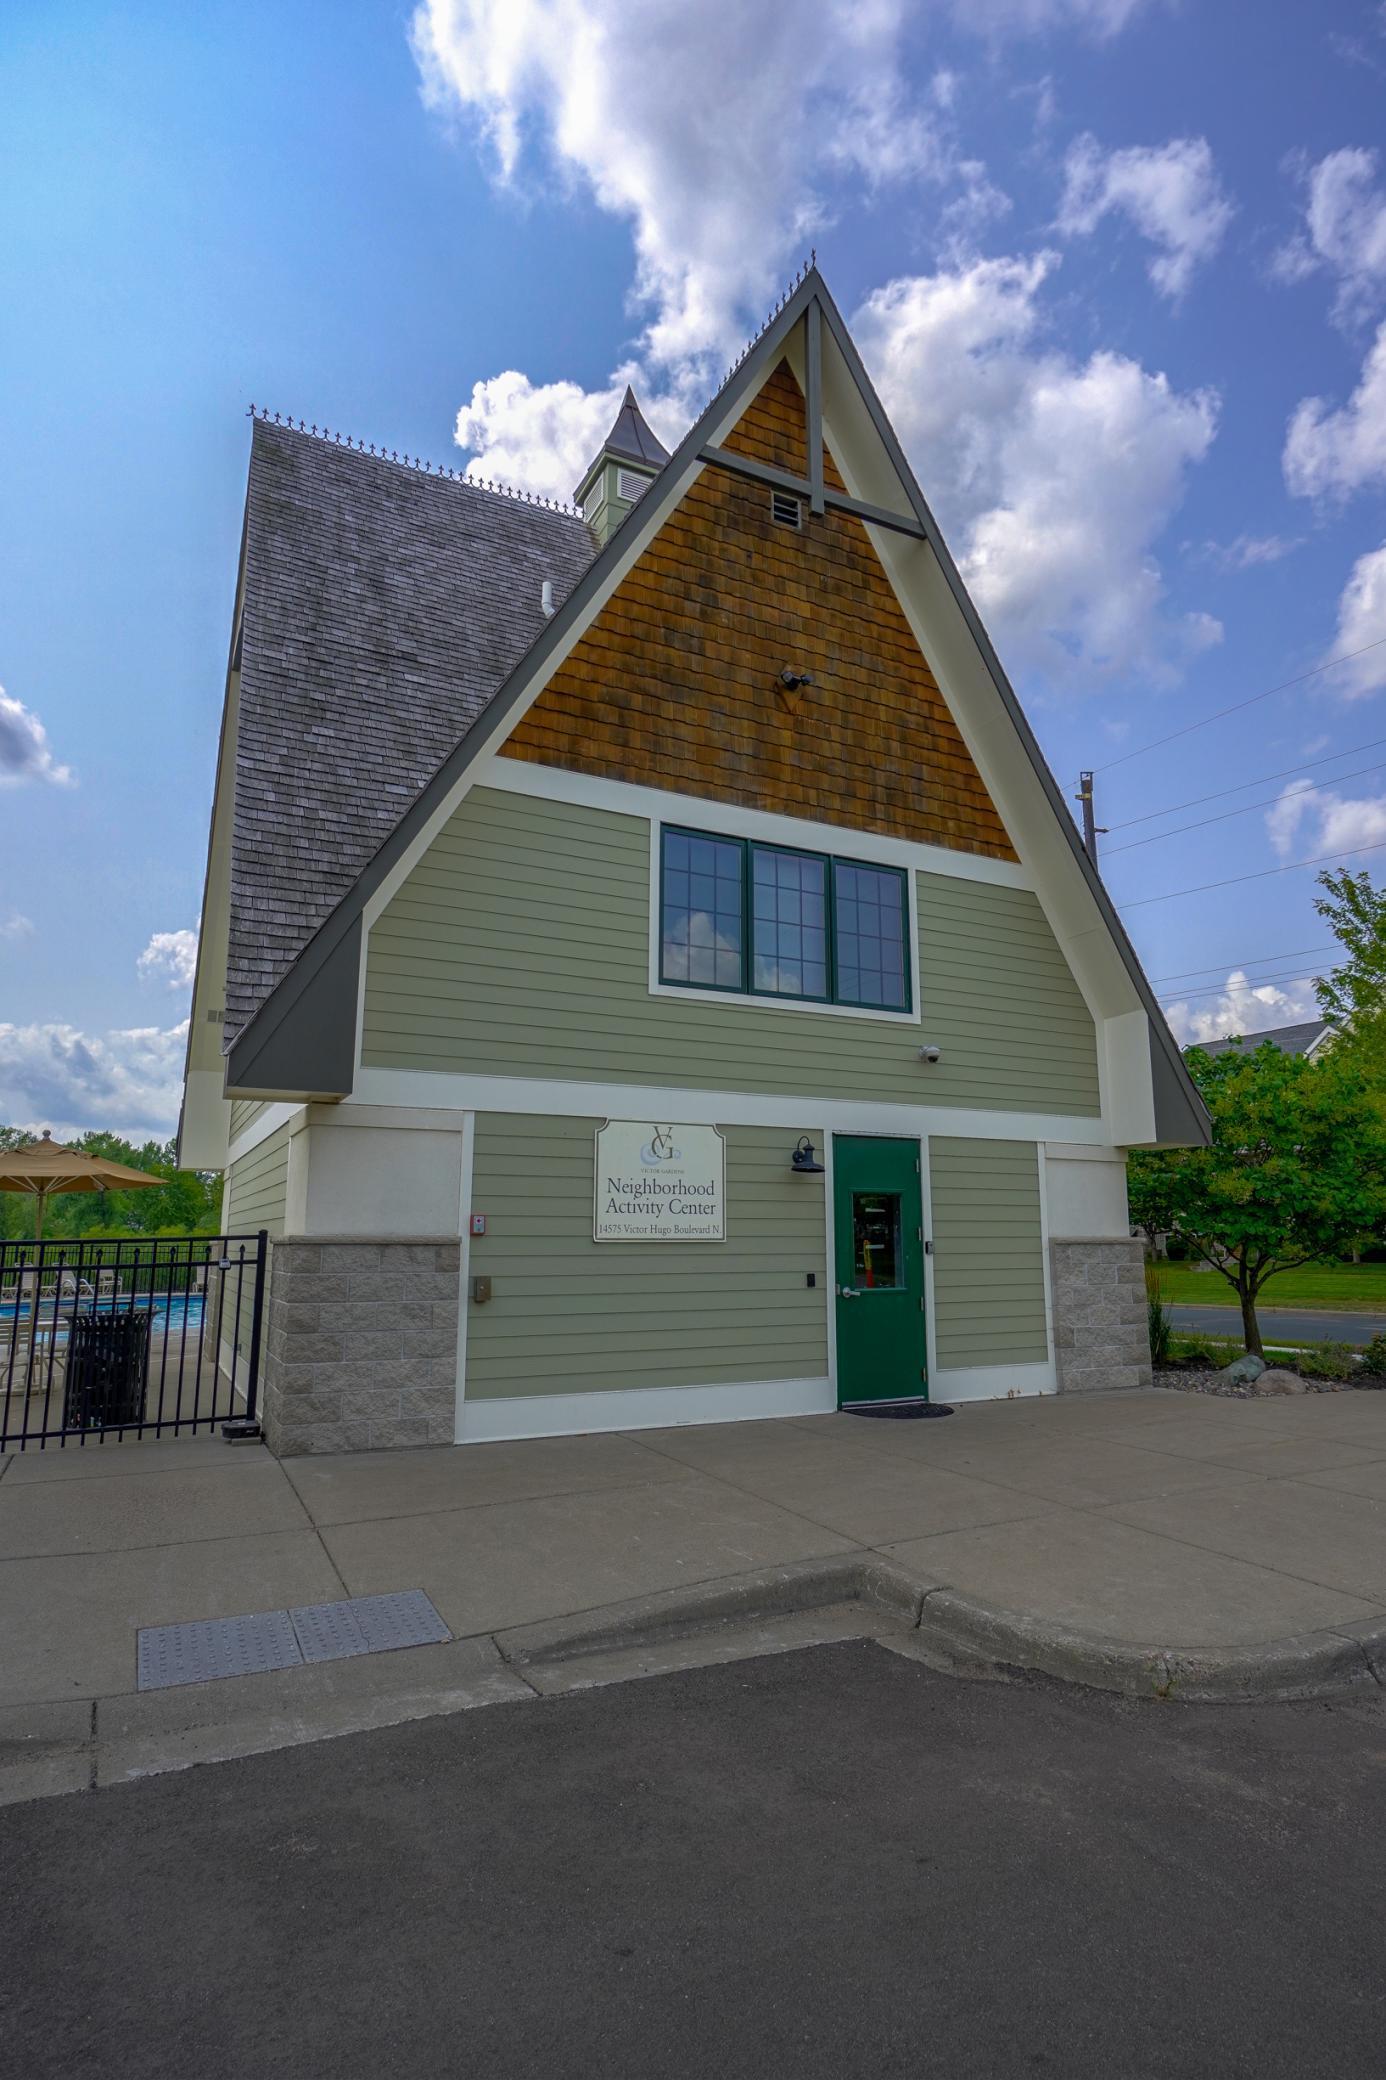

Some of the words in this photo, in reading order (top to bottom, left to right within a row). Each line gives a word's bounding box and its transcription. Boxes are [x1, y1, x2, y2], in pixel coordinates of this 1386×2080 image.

[607, 1177, 715, 1198] Neighborhood
[605, 1198, 664, 1218] Activity
[668, 1198, 717, 1215] Center
[599, 1224, 622, 1234] 14575
[624, 1224, 648, 1234] Victor
[650, 1224, 672, 1236] Hugo
[674, 1224, 711, 1234] Boulevard
